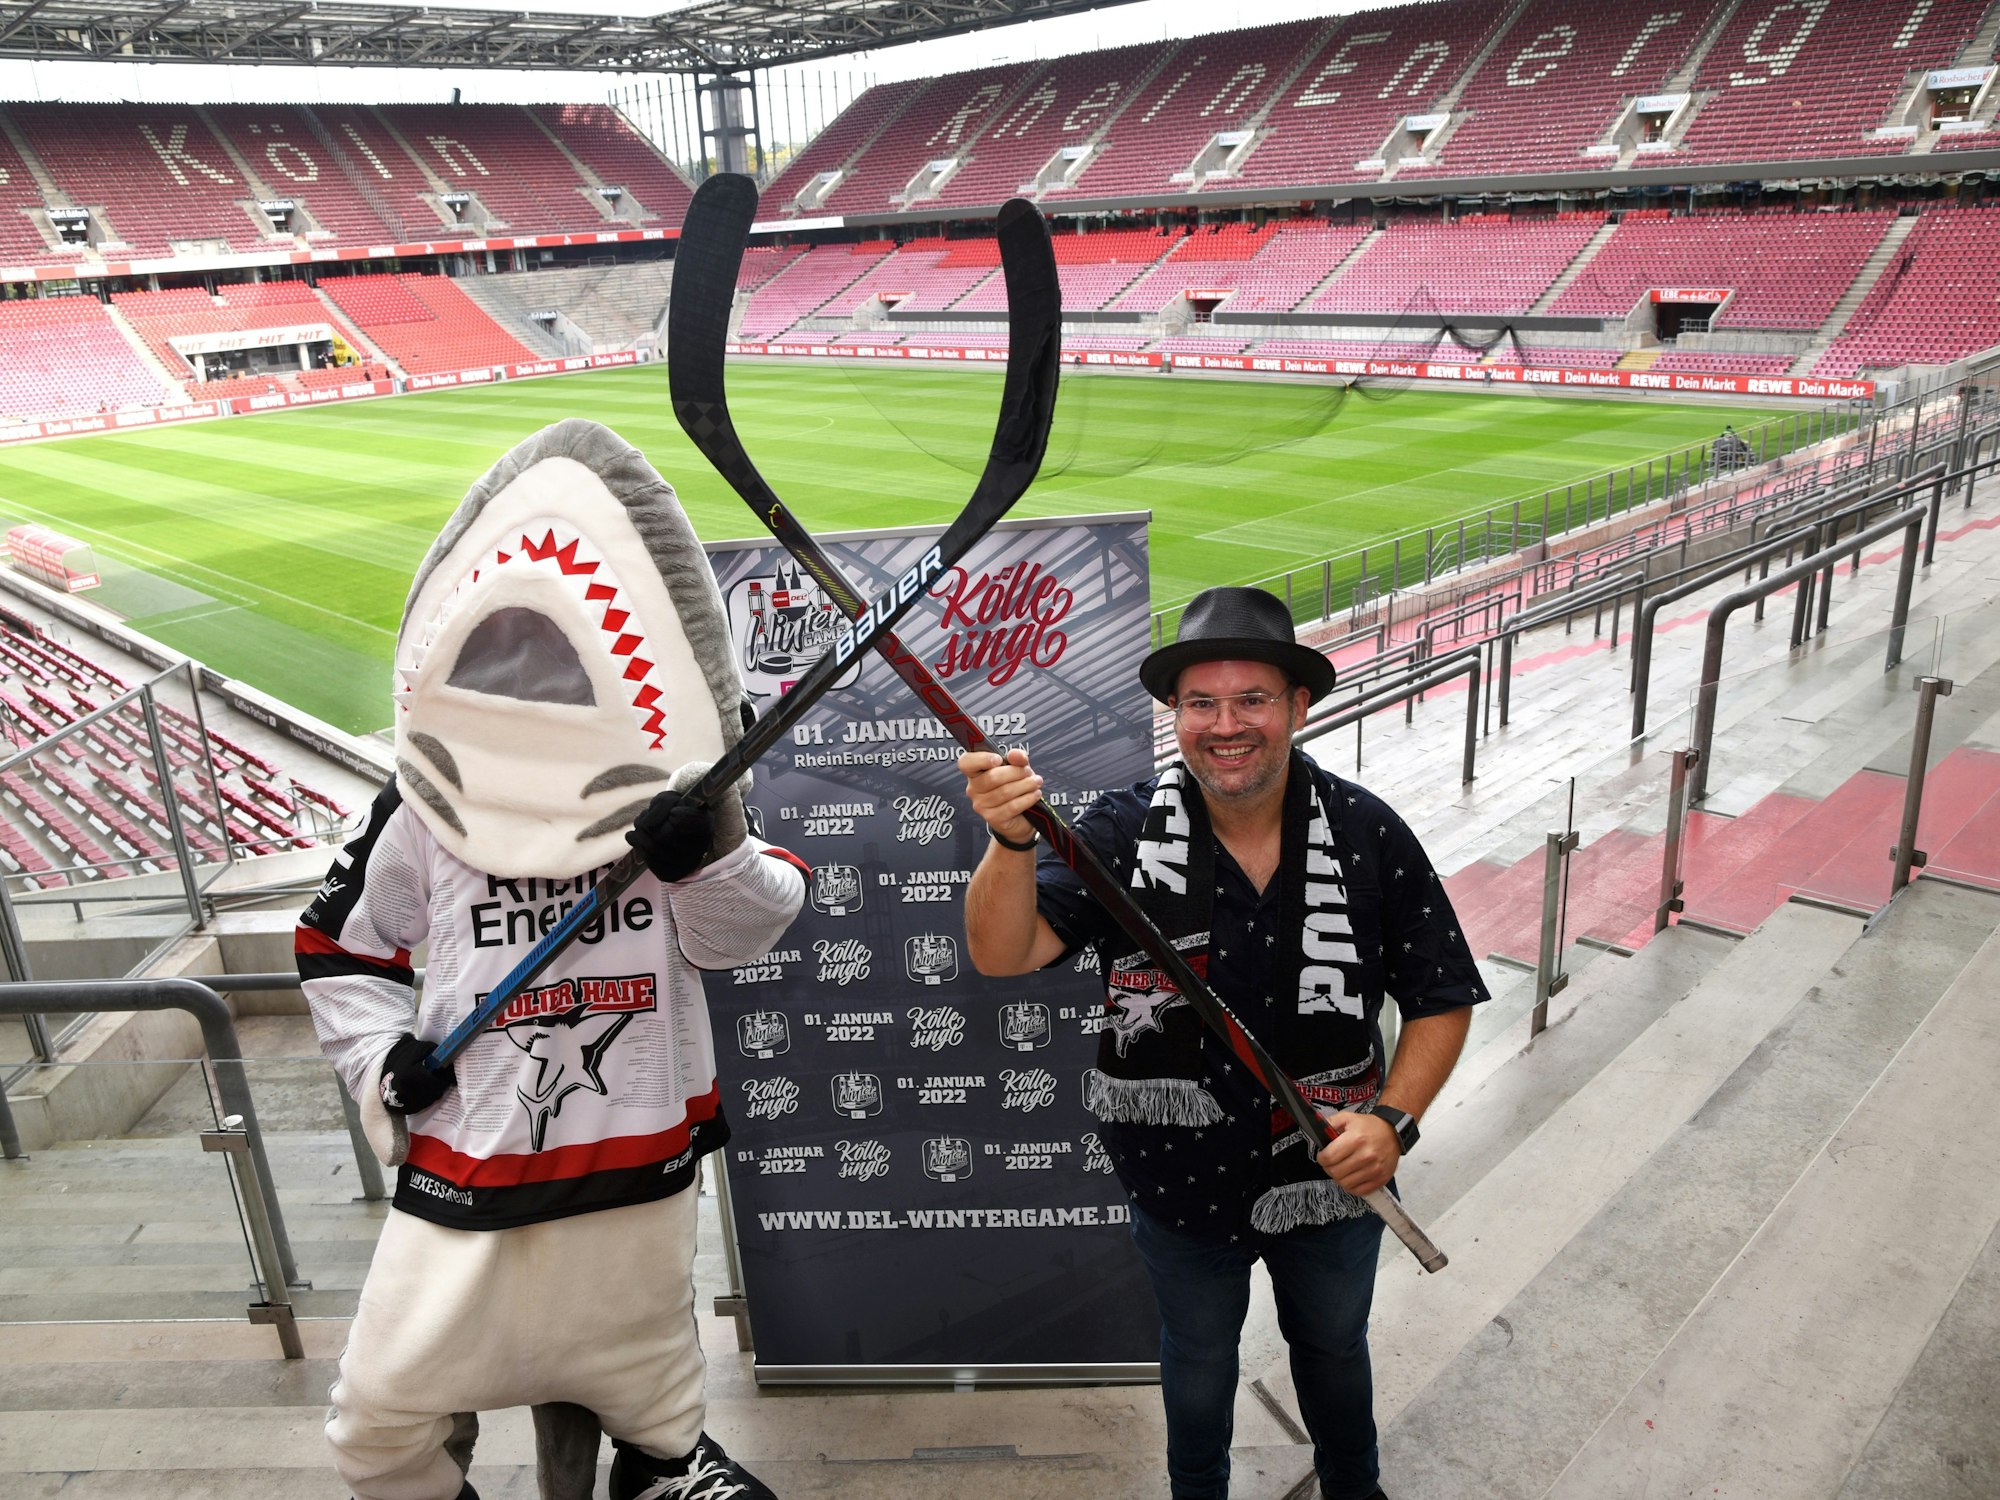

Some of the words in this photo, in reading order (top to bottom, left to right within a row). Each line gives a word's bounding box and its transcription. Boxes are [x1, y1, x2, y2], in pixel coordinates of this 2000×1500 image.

[258, 333, 286, 345] HIT
[297, 329, 324, 341] HIT
[1087, 353, 1111, 364] REWE
[1175, 355, 1201, 367] REWE
[1204, 357, 1221, 369] Dein
[1222, 357, 1243, 369] Markt
[1253, 358, 1281, 371] REWE
[1284, 360, 1302, 372] Dein
[1303, 360, 1327, 373] Markt
[1335, 361, 1366, 375] REWE
[1370, 363, 1389, 376] Dein
[1390, 363, 1416, 377] Markt
[1427, 365, 1461, 380] REWE
[1465, 366, 1485, 380] Dein
[1522, 368, 1560, 383] REWE
[1564, 371, 1587, 384] Dein
[1588, 371, 1621, 386] Markt
[1630, 373, 1671, 389] REWE
[1675, 375, 1700, 390] Dein
[1701, 376, 1737, 392] Markt
[1747, 378, 1792, 394] REWE
[1798, 380, 1826, 396] Dein
[1827, 381, 1867, 397] Markt
[927, 559, 1074, 632] Kölle
[743, 605, 843, 672] Winter
[794, 723, 835, 747] 01.
[892, 794, 955, 822] Kölle
[1049, 792, 1074, 807] 01.
[780, 805, 804, 821] 01.
[809, 802, 875, 819] JANUAR
[804, 819, 856, 837] 2022
[878, 873, 903, 886] 01.
[907, 870, 970, 885] JANUAR
[901, 885, 953, 903] 2022
[812, 938, 872, 965] Kölle
[732, 964, 783, 985] 2022
[580, 976, 655, 1011] HAIE
[804, 1013, 828, 1026] 01.
[831, 1012, 894, 1026] JANUAR
[907, 1006, 966, 1031] Kölle
[1059, 1007, 1083, 1020] 01.
[826, 1026, 875, 1041] 2022
[741, 1076, 800, 1101] Kölle
[897, 1077, 920, 1090] 01.
[923, 1076, 986, 1089] JANUAR
[998, 1068, 1057, 1092] Kölle
[918, 1089, 967, 1105] 2022
[737, 1149, 761, 1162] 01.
[764, 1146, 824, 1161] JANUAR
[834, 1140, 891, 1163] Kölle
[984, 1143, 1008, 1156] 01.
[1010, 1141, 1073, 1155] JANUAR
[759, 1159, 807, 1175] 2022
[1004, 1155, 1053, 1171] 2022
